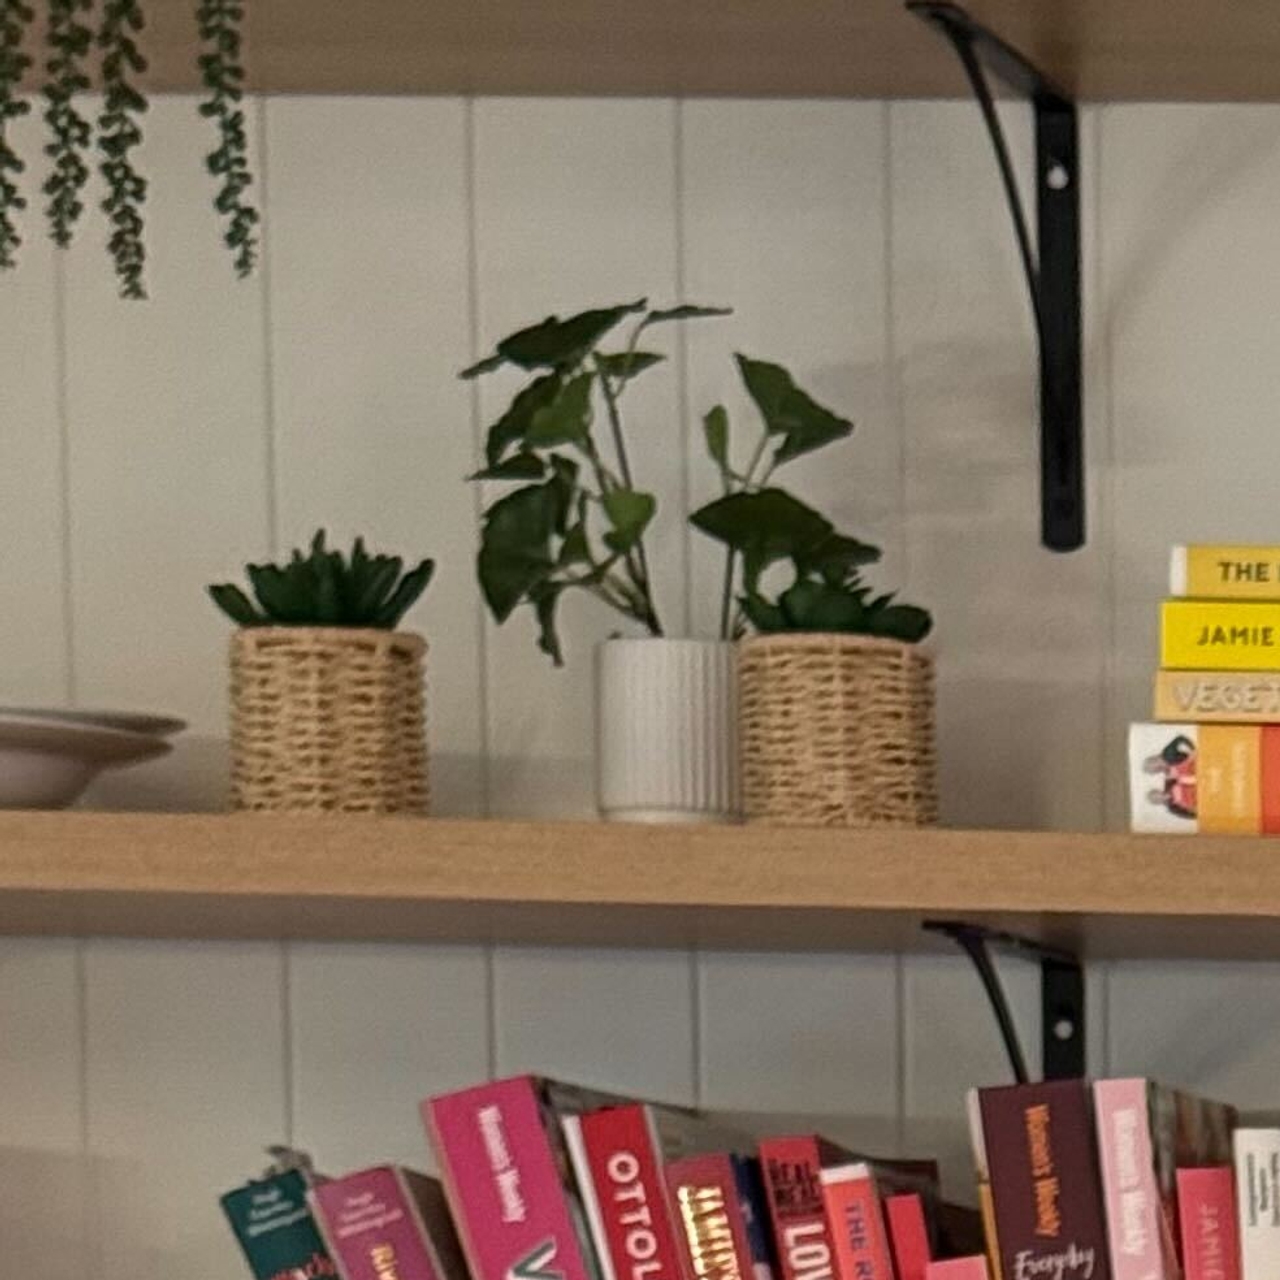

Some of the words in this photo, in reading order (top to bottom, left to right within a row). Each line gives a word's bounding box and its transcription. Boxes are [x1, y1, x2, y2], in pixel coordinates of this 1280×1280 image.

[1217, 562, 1270, 582] THE
[1197, 626, 1274, 647] JAMIE
[843, 1203, 866, 1251] THE
[1033, 1176, 1060, 1237] Weekly
[1197, 1203, 1224, 1280] JAMIE
